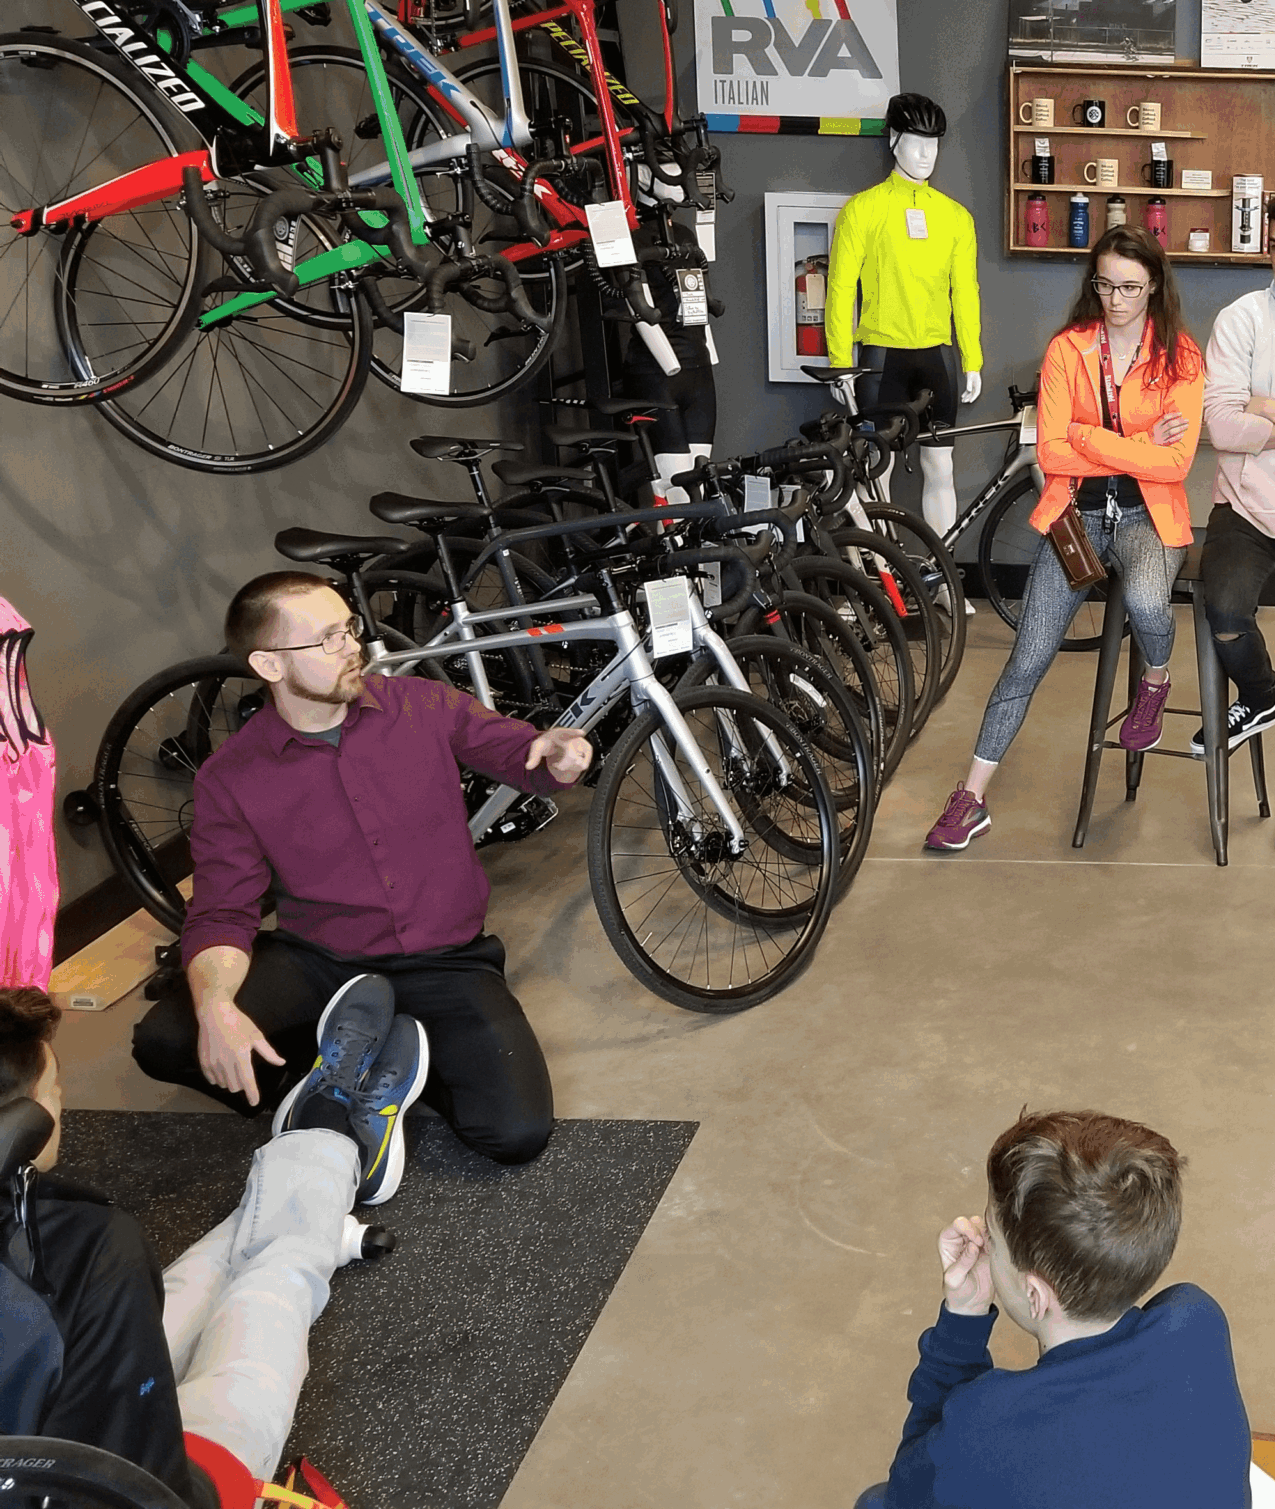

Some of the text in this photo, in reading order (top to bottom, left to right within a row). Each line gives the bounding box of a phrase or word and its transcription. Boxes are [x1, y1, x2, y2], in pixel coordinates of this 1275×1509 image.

[74, 0, 206, 112] CIALIZED
[364, 3, 462, 102] TREK
[711, 16, 884, 79] RVA
[713, 79, 769, 106] ITALIAN
[955, 472, 1011, 535] TREK
[0, 1458, 56, 1469] RAGER
